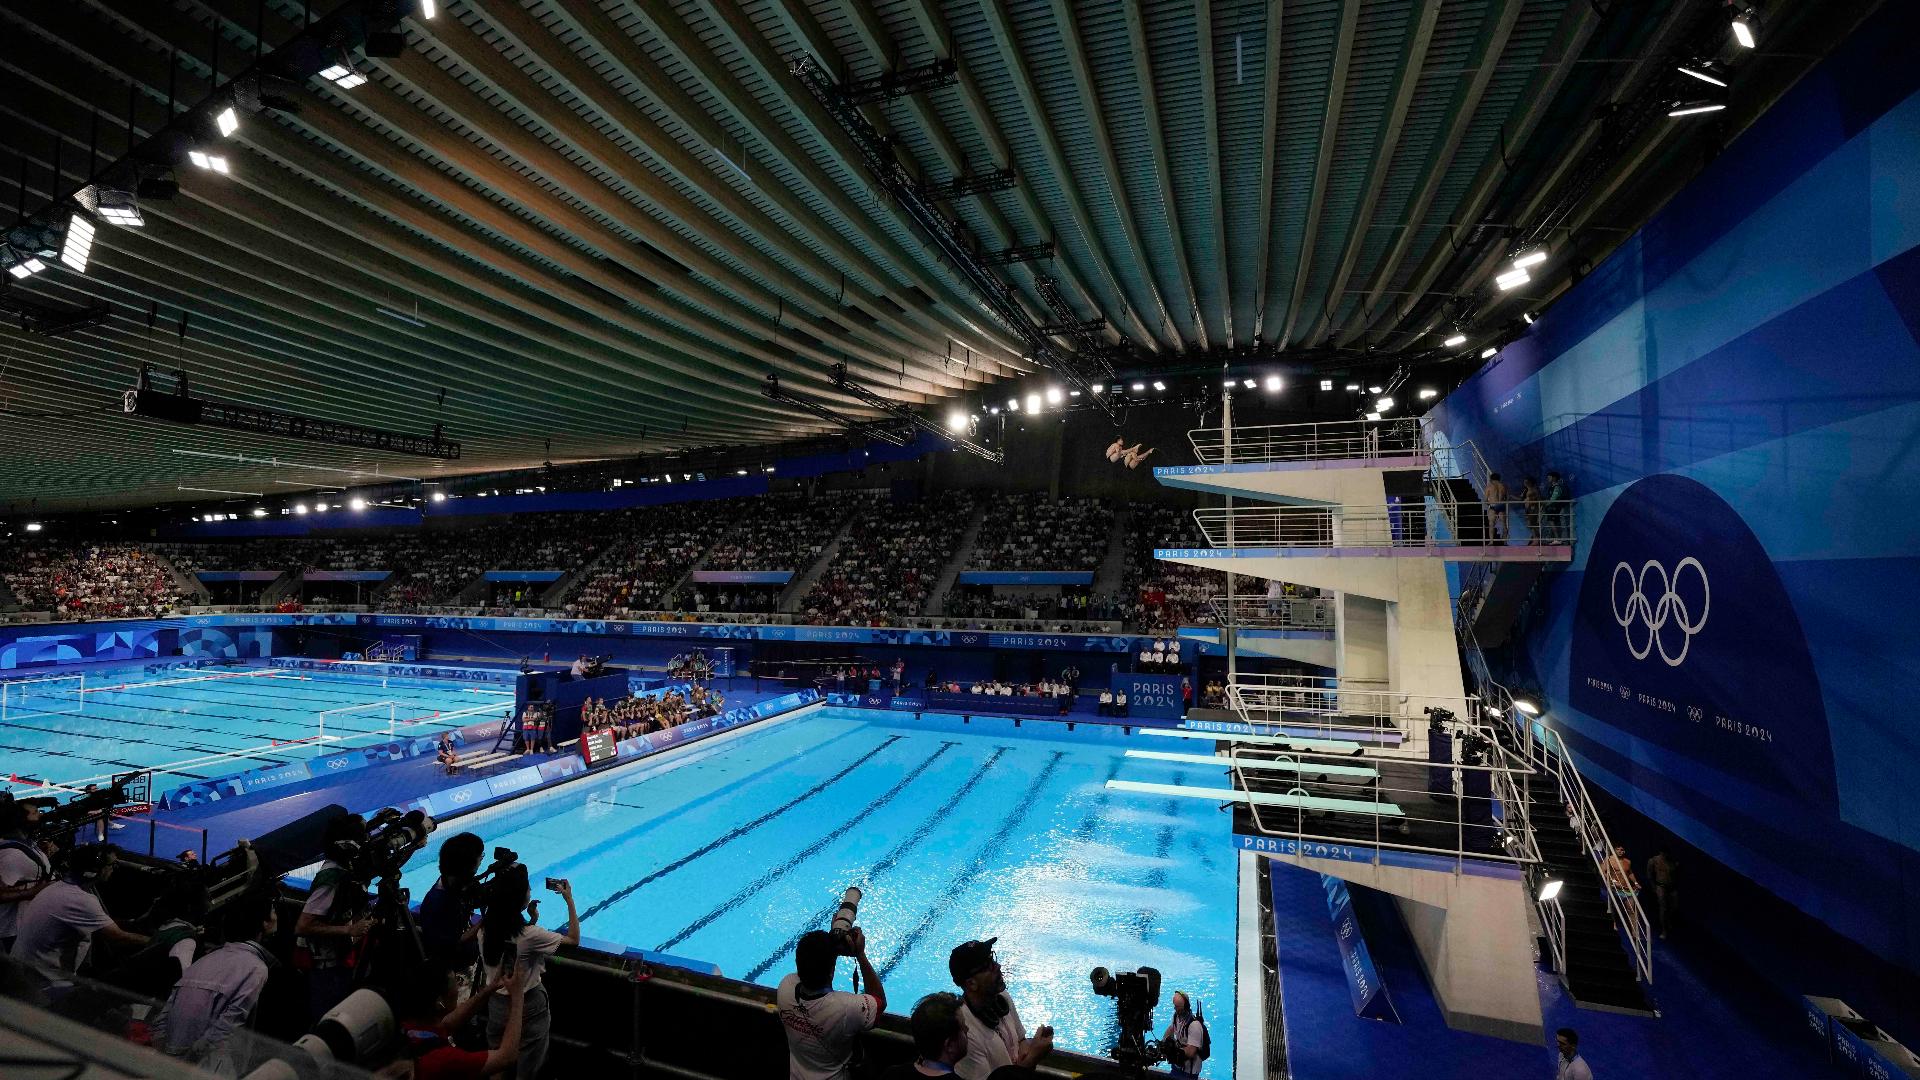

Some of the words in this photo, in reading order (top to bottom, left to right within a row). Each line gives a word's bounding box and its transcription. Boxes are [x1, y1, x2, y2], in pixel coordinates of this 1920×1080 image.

[1158, 550, 1190, 558] PARIS
[1193, 549, 1222, 558] 2024
[1003, 637, 1034, 646] PARIS
[1038, 638, 1066, 647] 2024
[1133, 682, 1174, 695] PARIS
[1133, 695, 1174, 707] 2024
[1638, 693, 1656, 707] PARIS
[1657, 698, 1676, 713] 2024
[1190, 721, 1222, 731] PARIS
[1716, 716, 1742, 734] PARIS
[1745, 724, 1772, 742] 2024
[1244, 837, 1296, 852] PARIS
[1303, 844, 1352, 859] 2024
[1351, 951, 1362, 977] PARIS
[1357, 974, 1369, 1000] 2024
